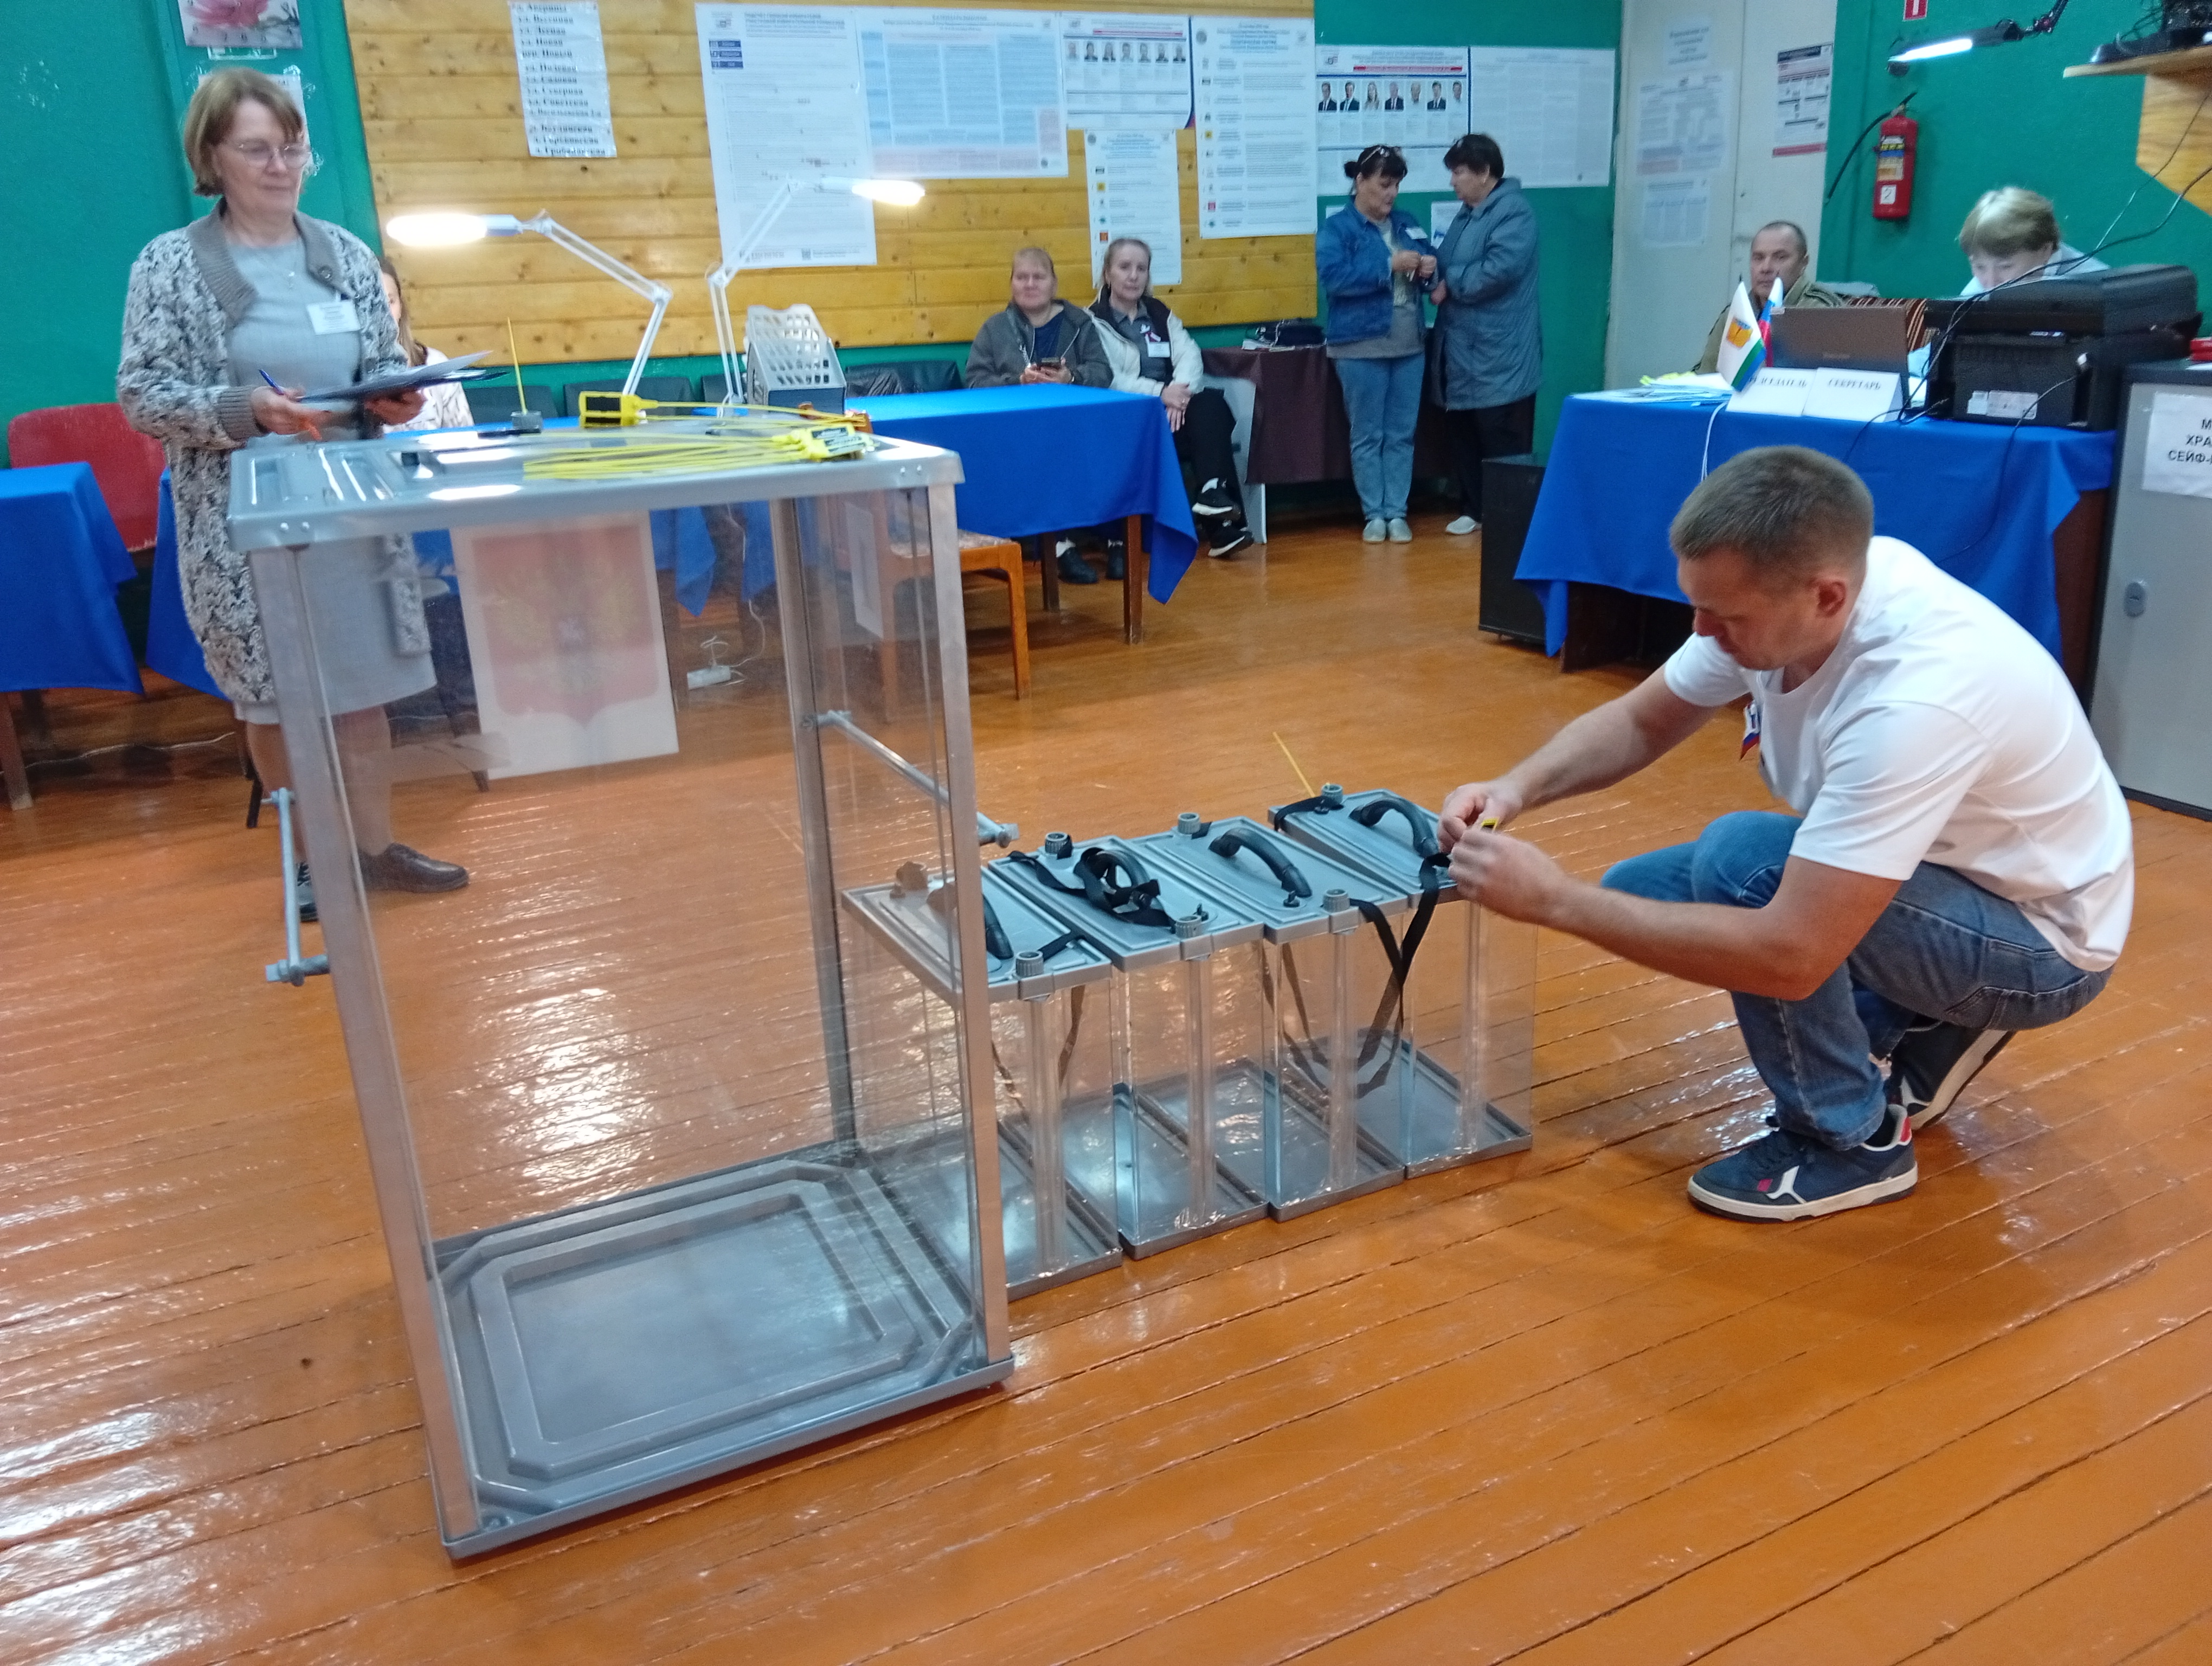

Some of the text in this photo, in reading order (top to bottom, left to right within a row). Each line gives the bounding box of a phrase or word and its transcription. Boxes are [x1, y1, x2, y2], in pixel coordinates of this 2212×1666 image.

[1828, 377, 1881, 390] СЕКРЕТАРЬ
[2201, 418, 2212, 430] М
[2185, 434, 2212, 447] ХРА
